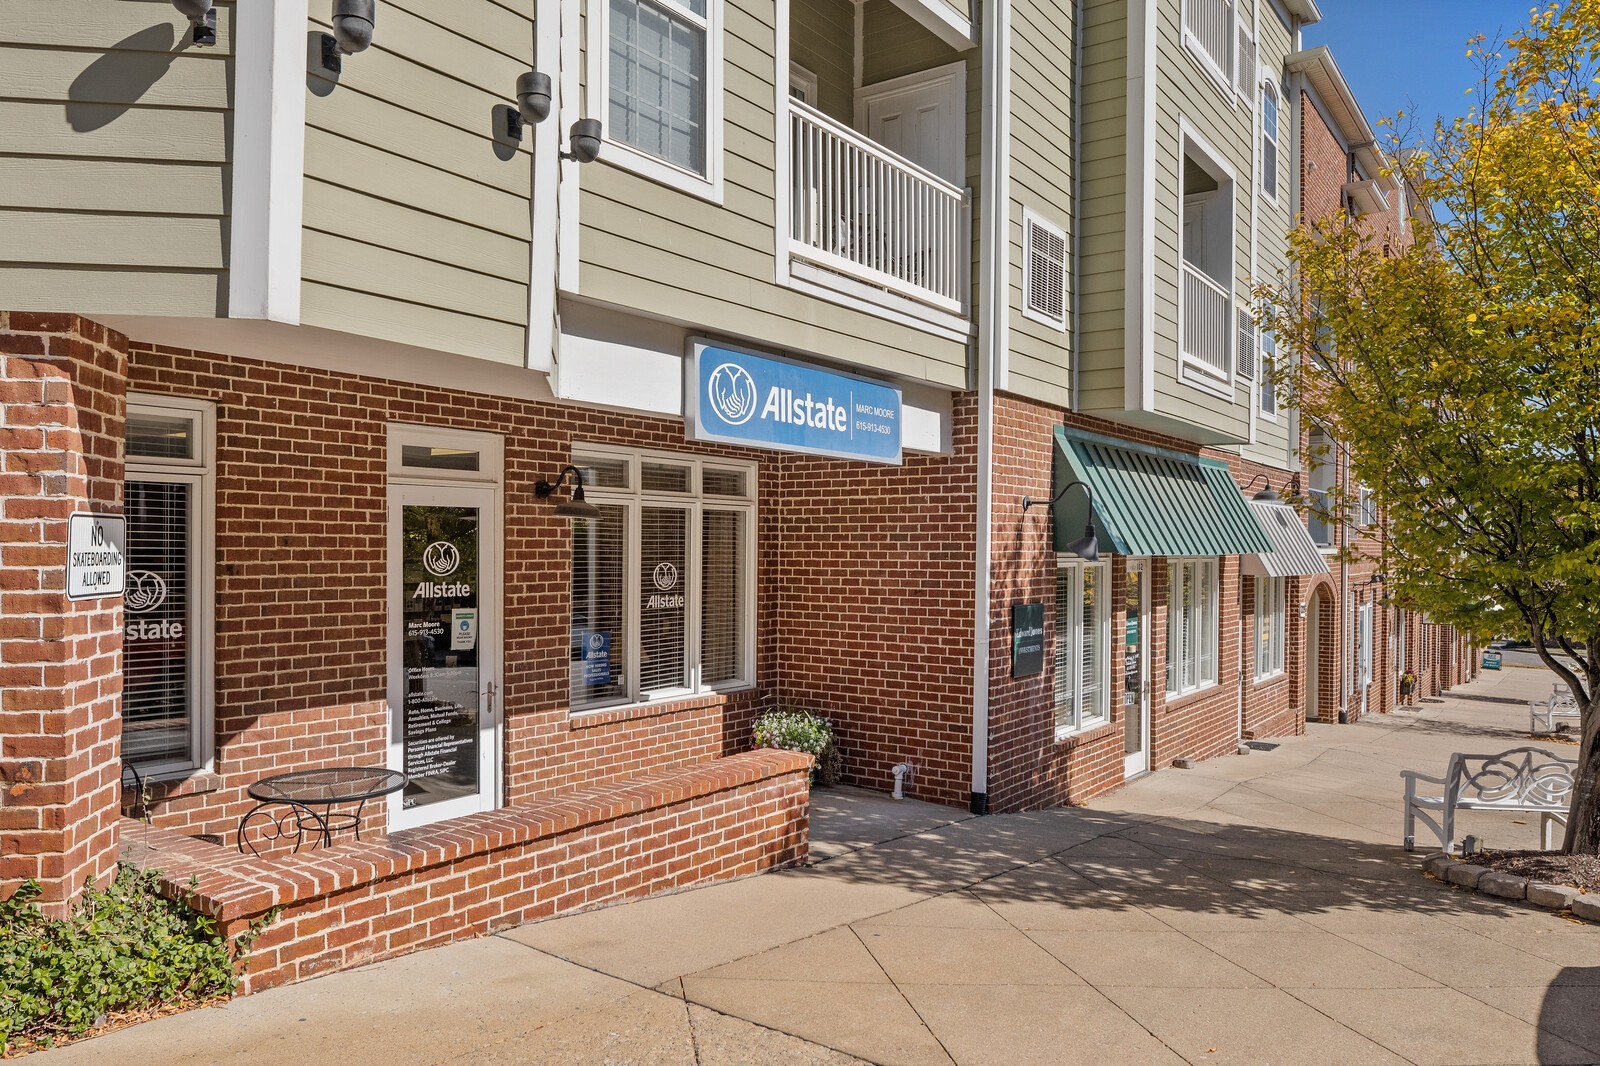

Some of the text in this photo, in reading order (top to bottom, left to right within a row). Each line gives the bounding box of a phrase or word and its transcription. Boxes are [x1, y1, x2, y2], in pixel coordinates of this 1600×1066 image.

[760, 385, 848, 433] Allstate
[855, 403, 895, 420] MARC MOORE
[855, 420, 892, 436] 615-913-4530
[91, 525, 104, 547] NO
[73, 551, 122, 567] SKATEBOARDING
[82, 571, 111, 587] ALLOWED
[412, 581, 471, 599] Allstate
[646, 594, 685, 609] Allstate
[123, 620, 183, 641] state
[408, 628, 444, 637] 615-913-4530
[586, 651, 608, 659] Allstate
[443, 738, 474, 747] Representatives
[430, 760, 457, 769] Broker-Dealer
